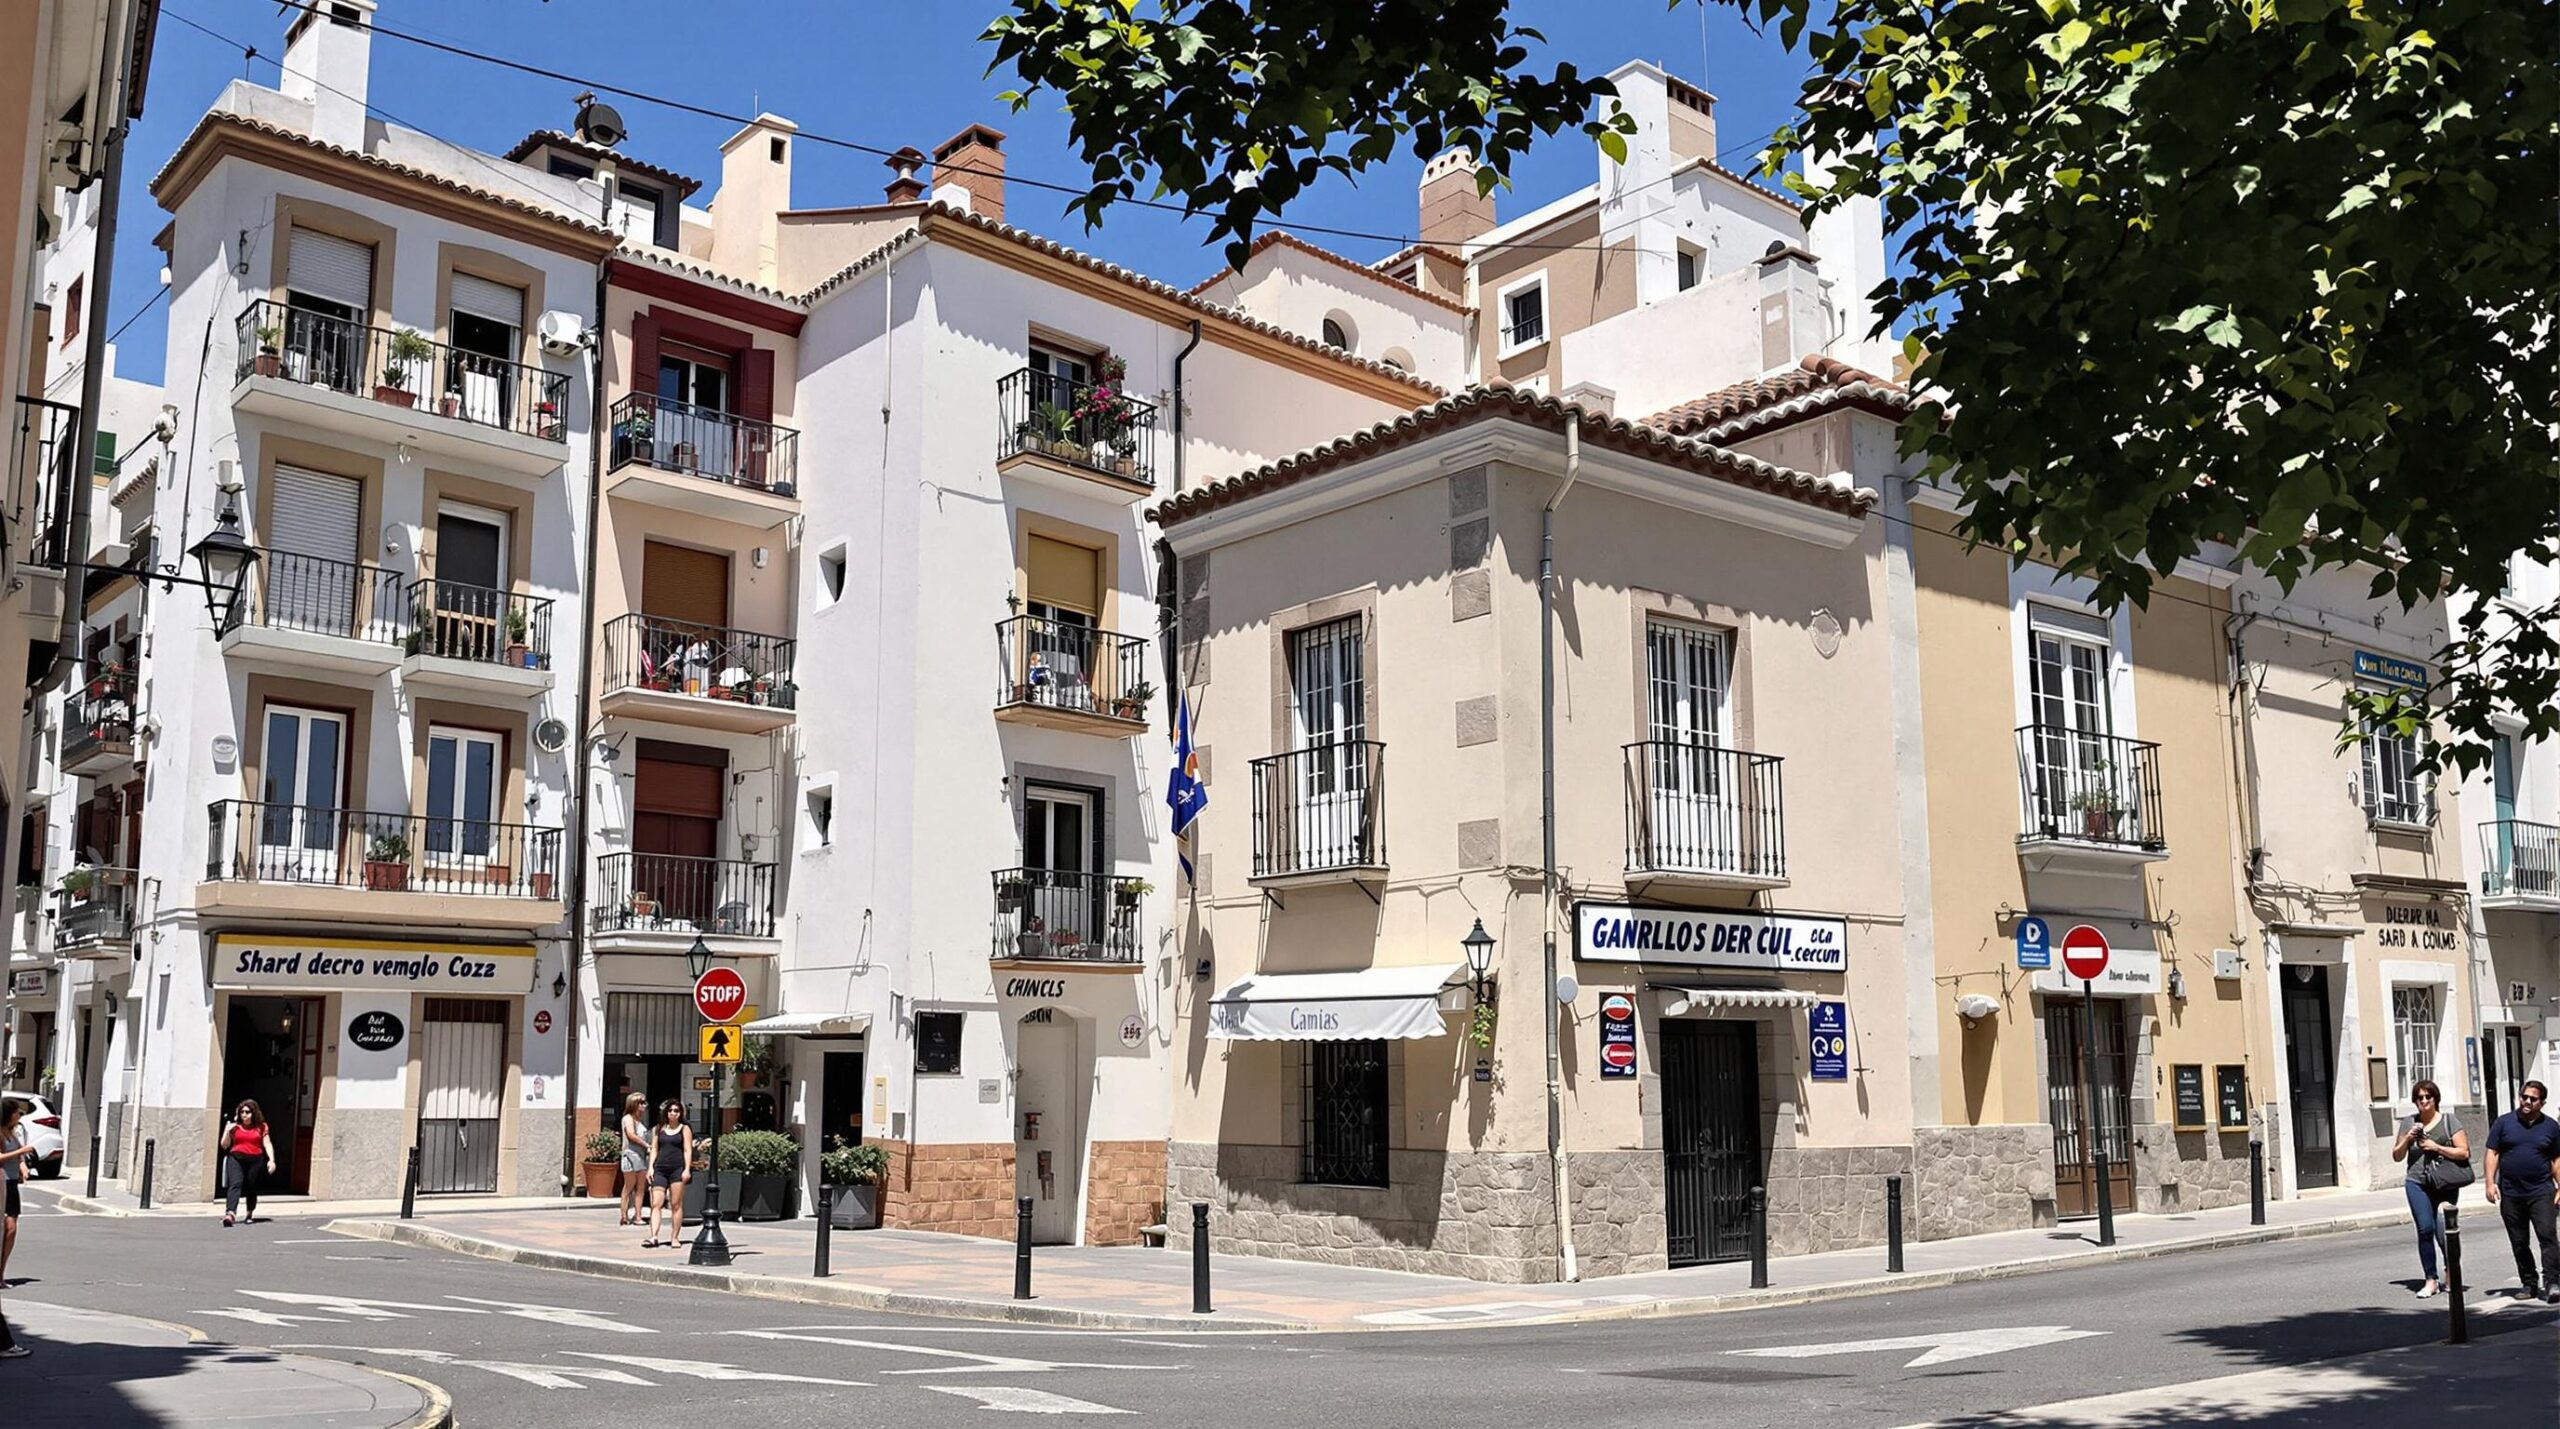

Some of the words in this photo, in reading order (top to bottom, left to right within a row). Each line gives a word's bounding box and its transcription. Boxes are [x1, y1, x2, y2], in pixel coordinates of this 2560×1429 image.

[1711, 923, 1752, 954] DER
[1756, 926, 1792, 955] CUL
[2411, 930, 2419, 948] A
[236, 950, 302, 974] Shard
[307, 952, 364, 976] decro
[372, 953, 440, 980] vemglo
[1290, 1007, 1339, 1031] Camias
